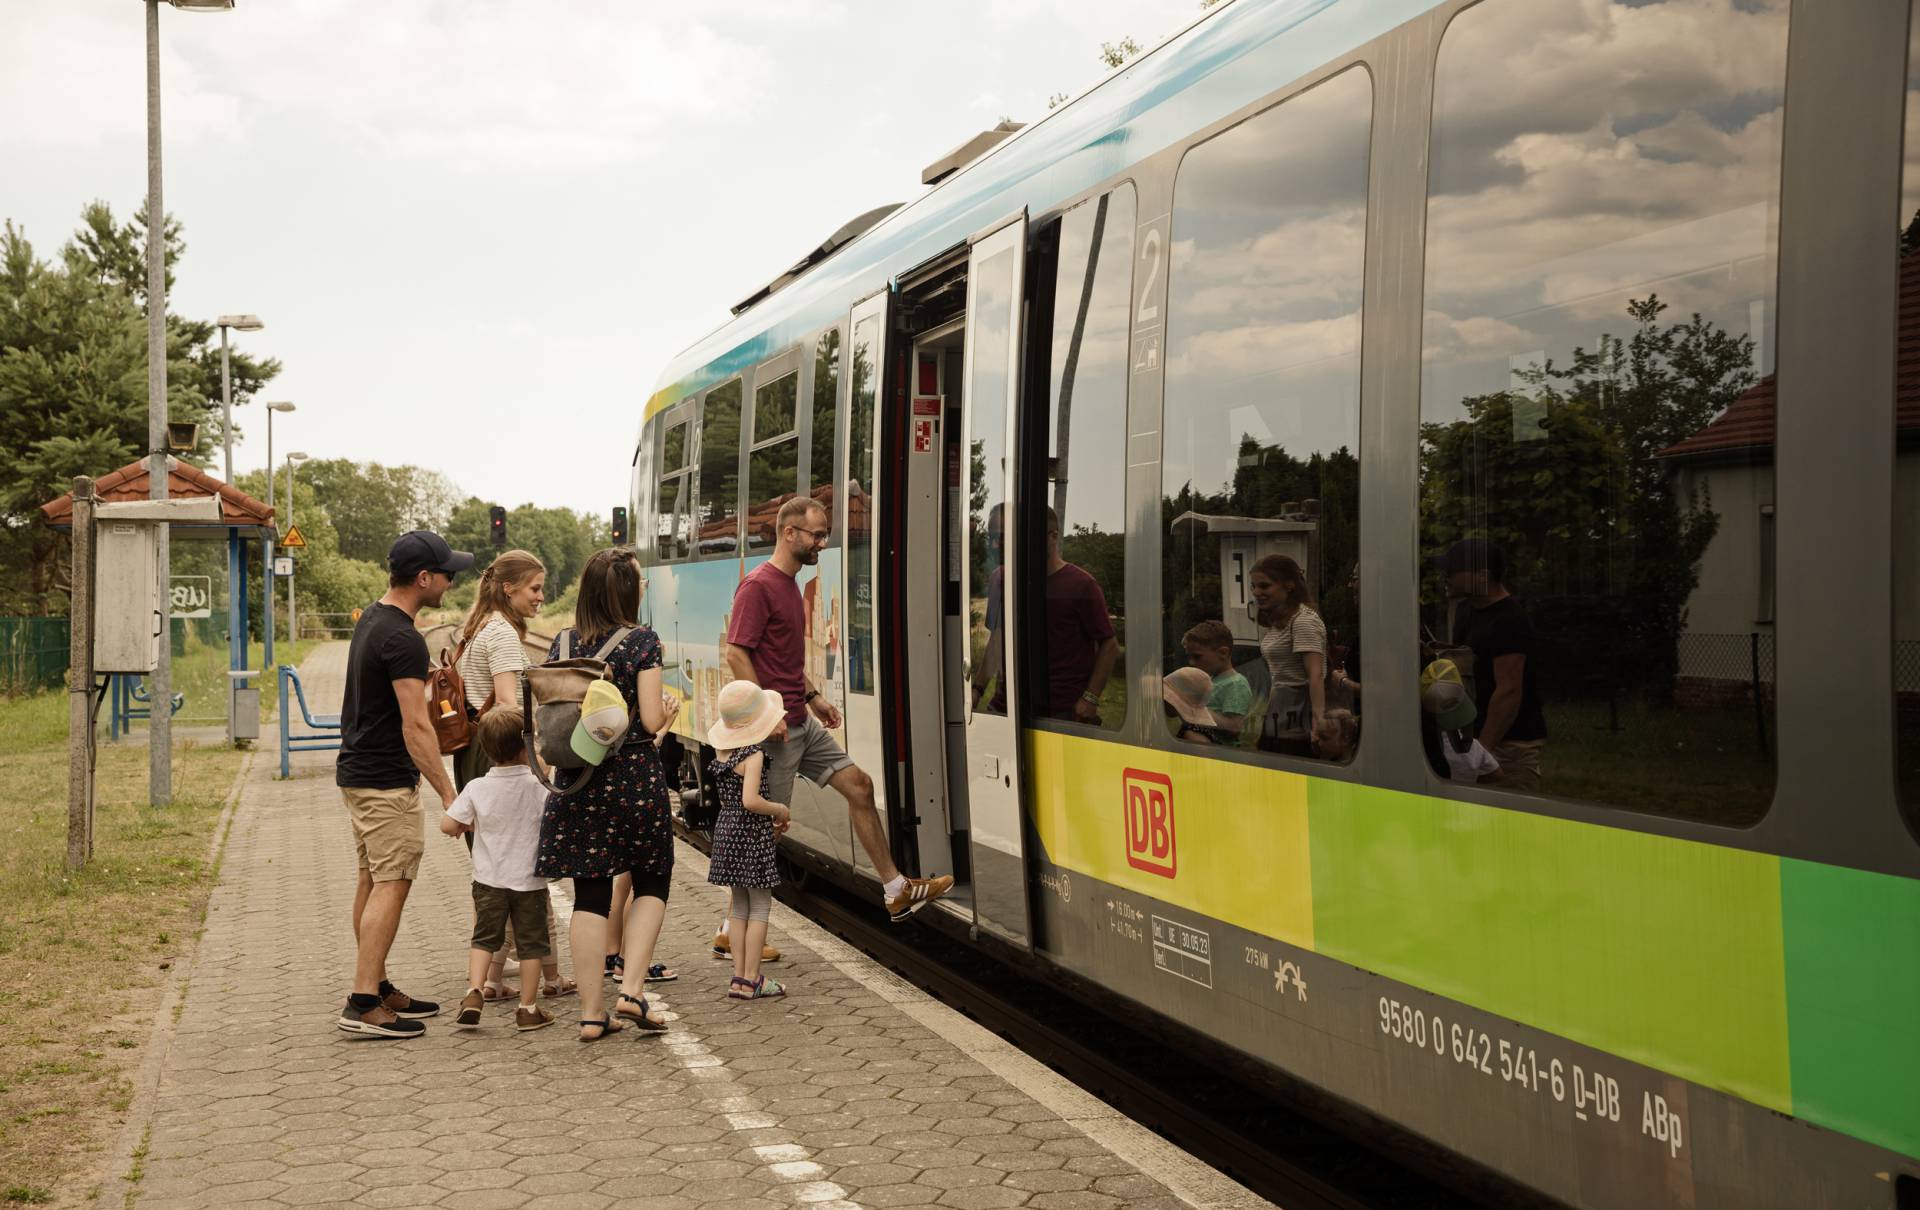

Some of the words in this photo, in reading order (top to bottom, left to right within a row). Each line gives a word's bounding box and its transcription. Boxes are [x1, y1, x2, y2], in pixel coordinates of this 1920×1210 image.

[1137, 228, 1161, 323] 2
[693, 427, 700, 472] 2
[1128, 784, 1170, 859] DB
[1181, 930, 1209, 955] 30.05.23
[1379, 996, 1426, 1048] 9580
[1432, 1016, 1445, 1056] 0
[1451, 1023, 1492, 1075] 642
[1499, 1038, 1565, 1101] 541-6
[1573, 1064, 1620, 1122] D-DB
[1642, 1090, 1683, 1158] ABp
